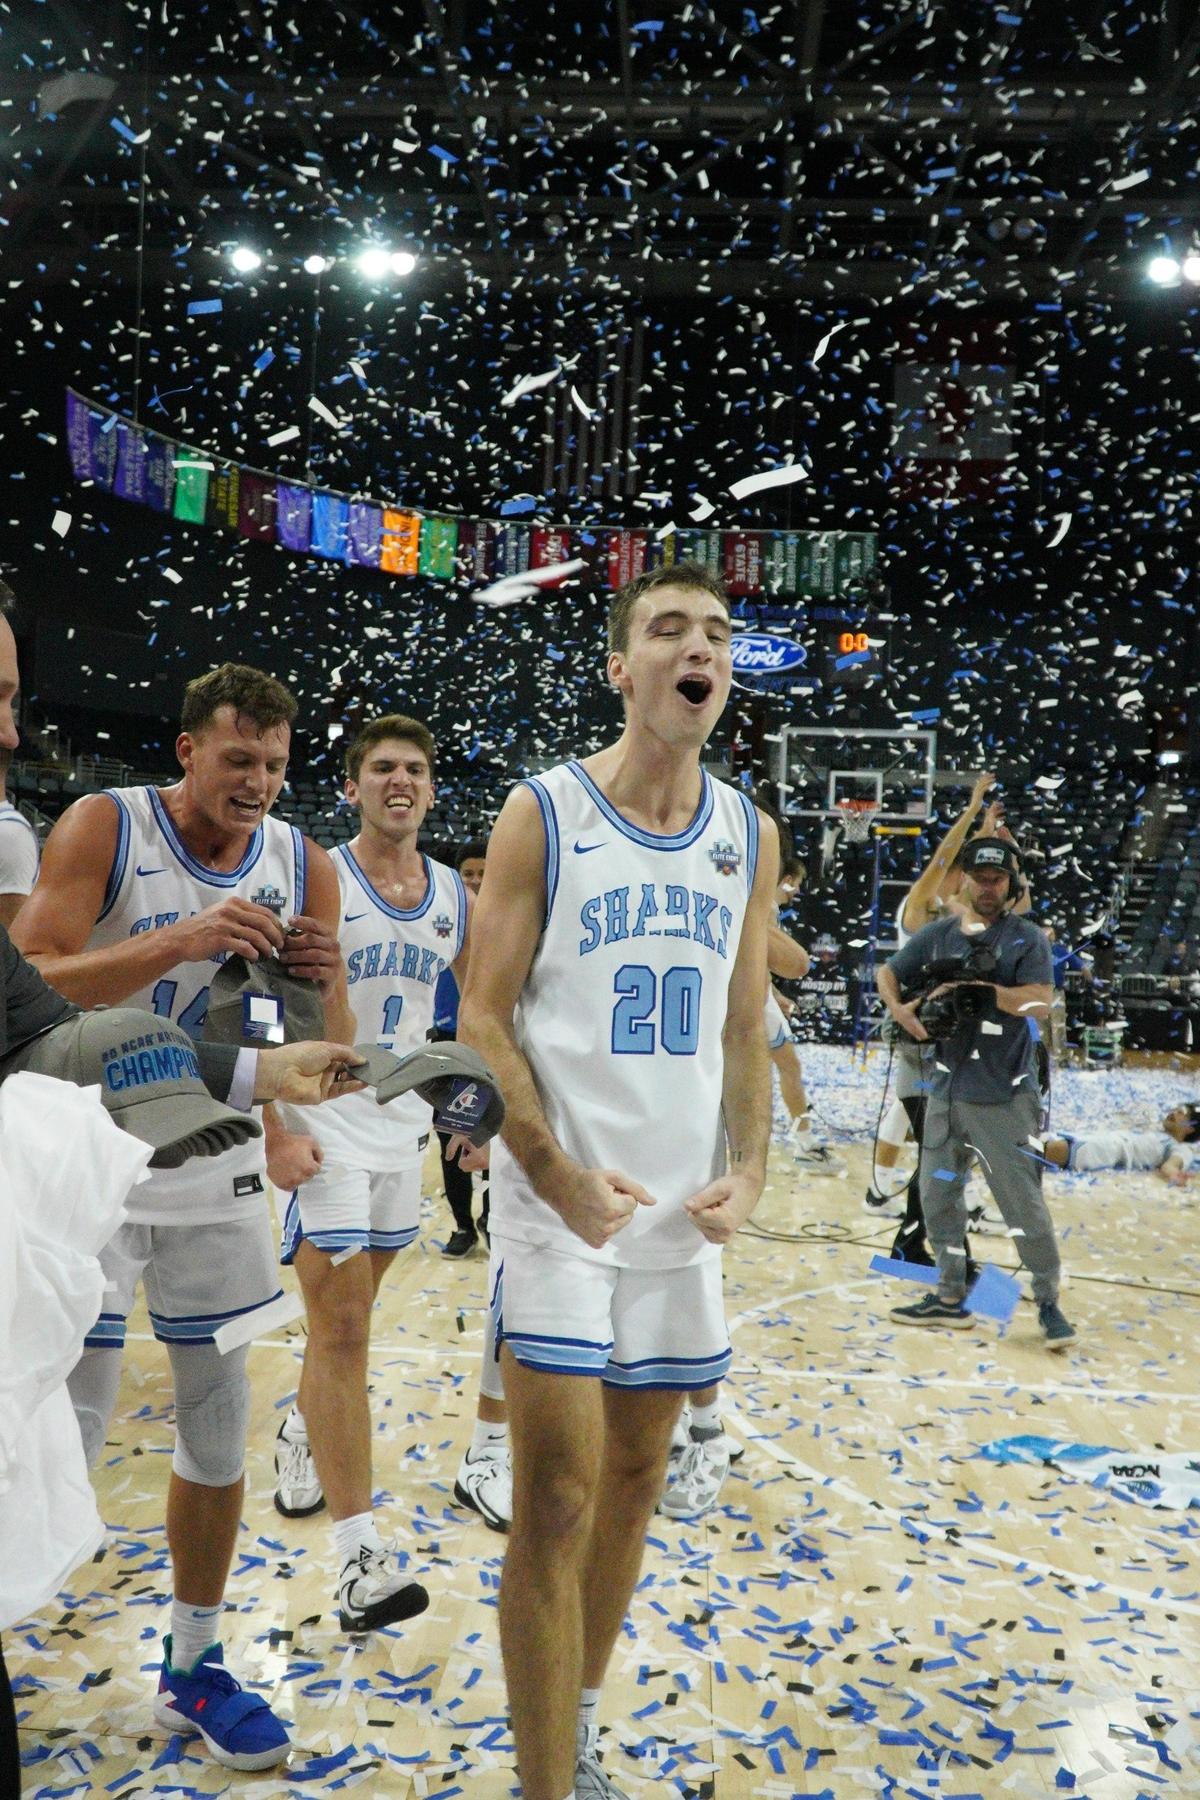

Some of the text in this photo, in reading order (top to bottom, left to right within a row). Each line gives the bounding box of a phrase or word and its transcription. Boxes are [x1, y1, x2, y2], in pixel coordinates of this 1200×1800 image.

[735, 544, 746, 582] STATE
[748, 540, 759, 585] FERRIS
[731, 637, 786, 667] Ford
[580, 883, 733, 959] SHARKS
[151, 979, 210, 1042] 14
[377, 995, 403, 1049] 1
[611, 964, 703, 1056] 20
[1112, 1465, 1161, 1479] NCAA
